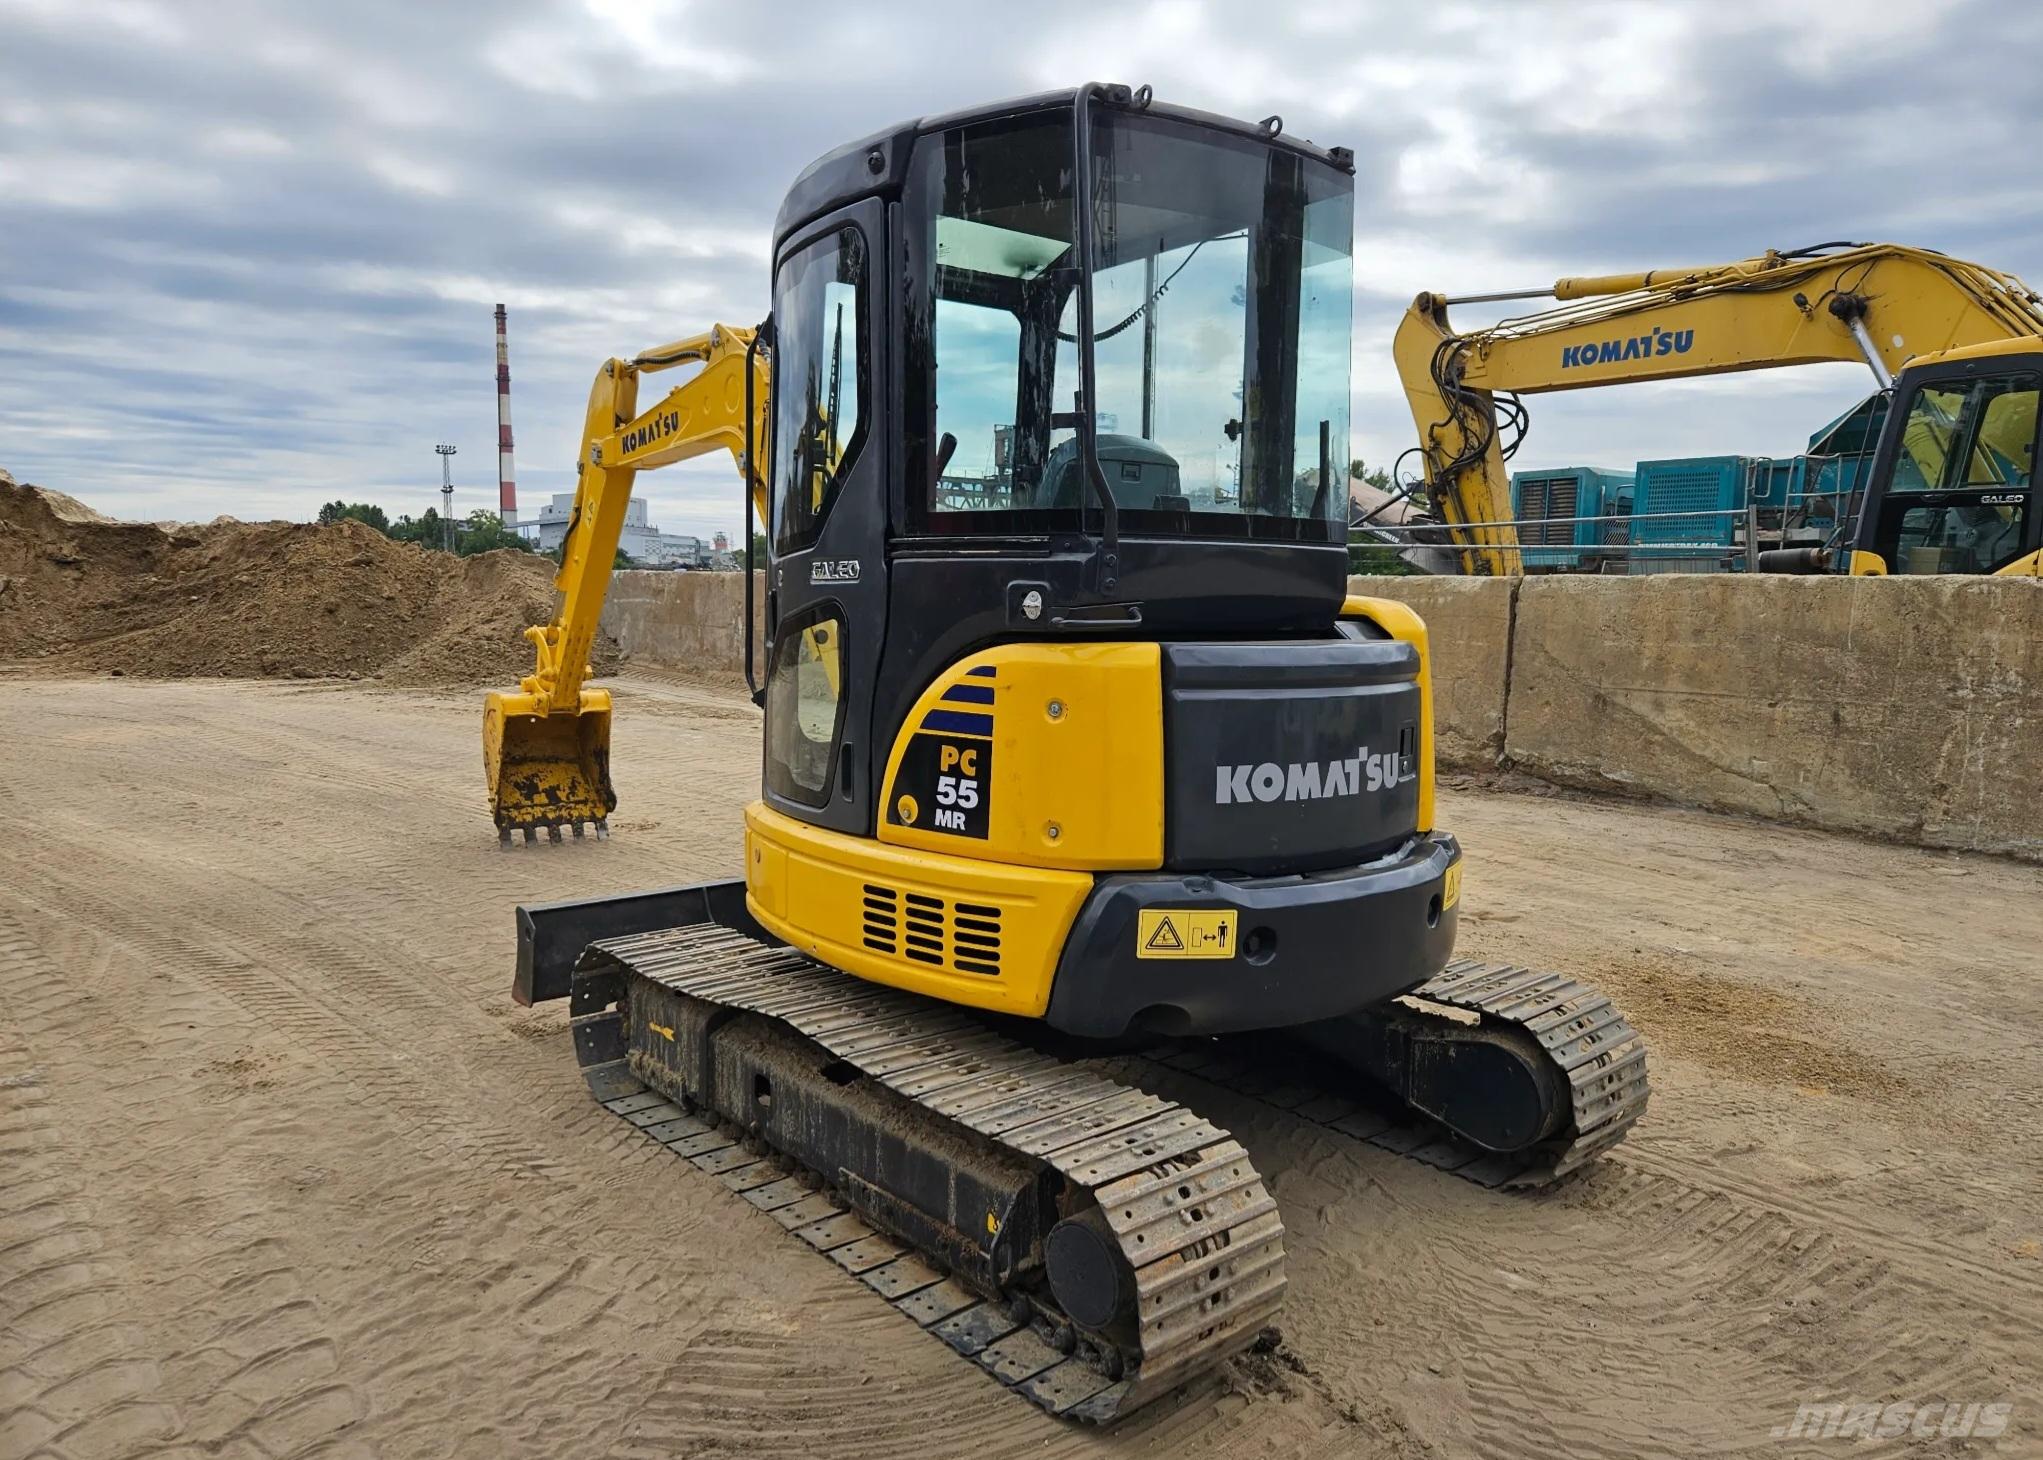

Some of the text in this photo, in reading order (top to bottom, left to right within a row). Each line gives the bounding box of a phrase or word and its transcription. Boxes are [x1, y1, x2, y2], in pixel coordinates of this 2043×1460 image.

[1562, 327, 1694, 368] KOMATSU
[622, 411, 679, 455] KOMATSU
[1980, 494, 2025, 503] GALEO
[812, 560, 860, 580] GALEO
[940, 745, 977, 777] PC
[1215, 746, 1399, 804] KOMATSU
[936, 775, 979, 809] 55
[934, 808, 966, 831] MR
